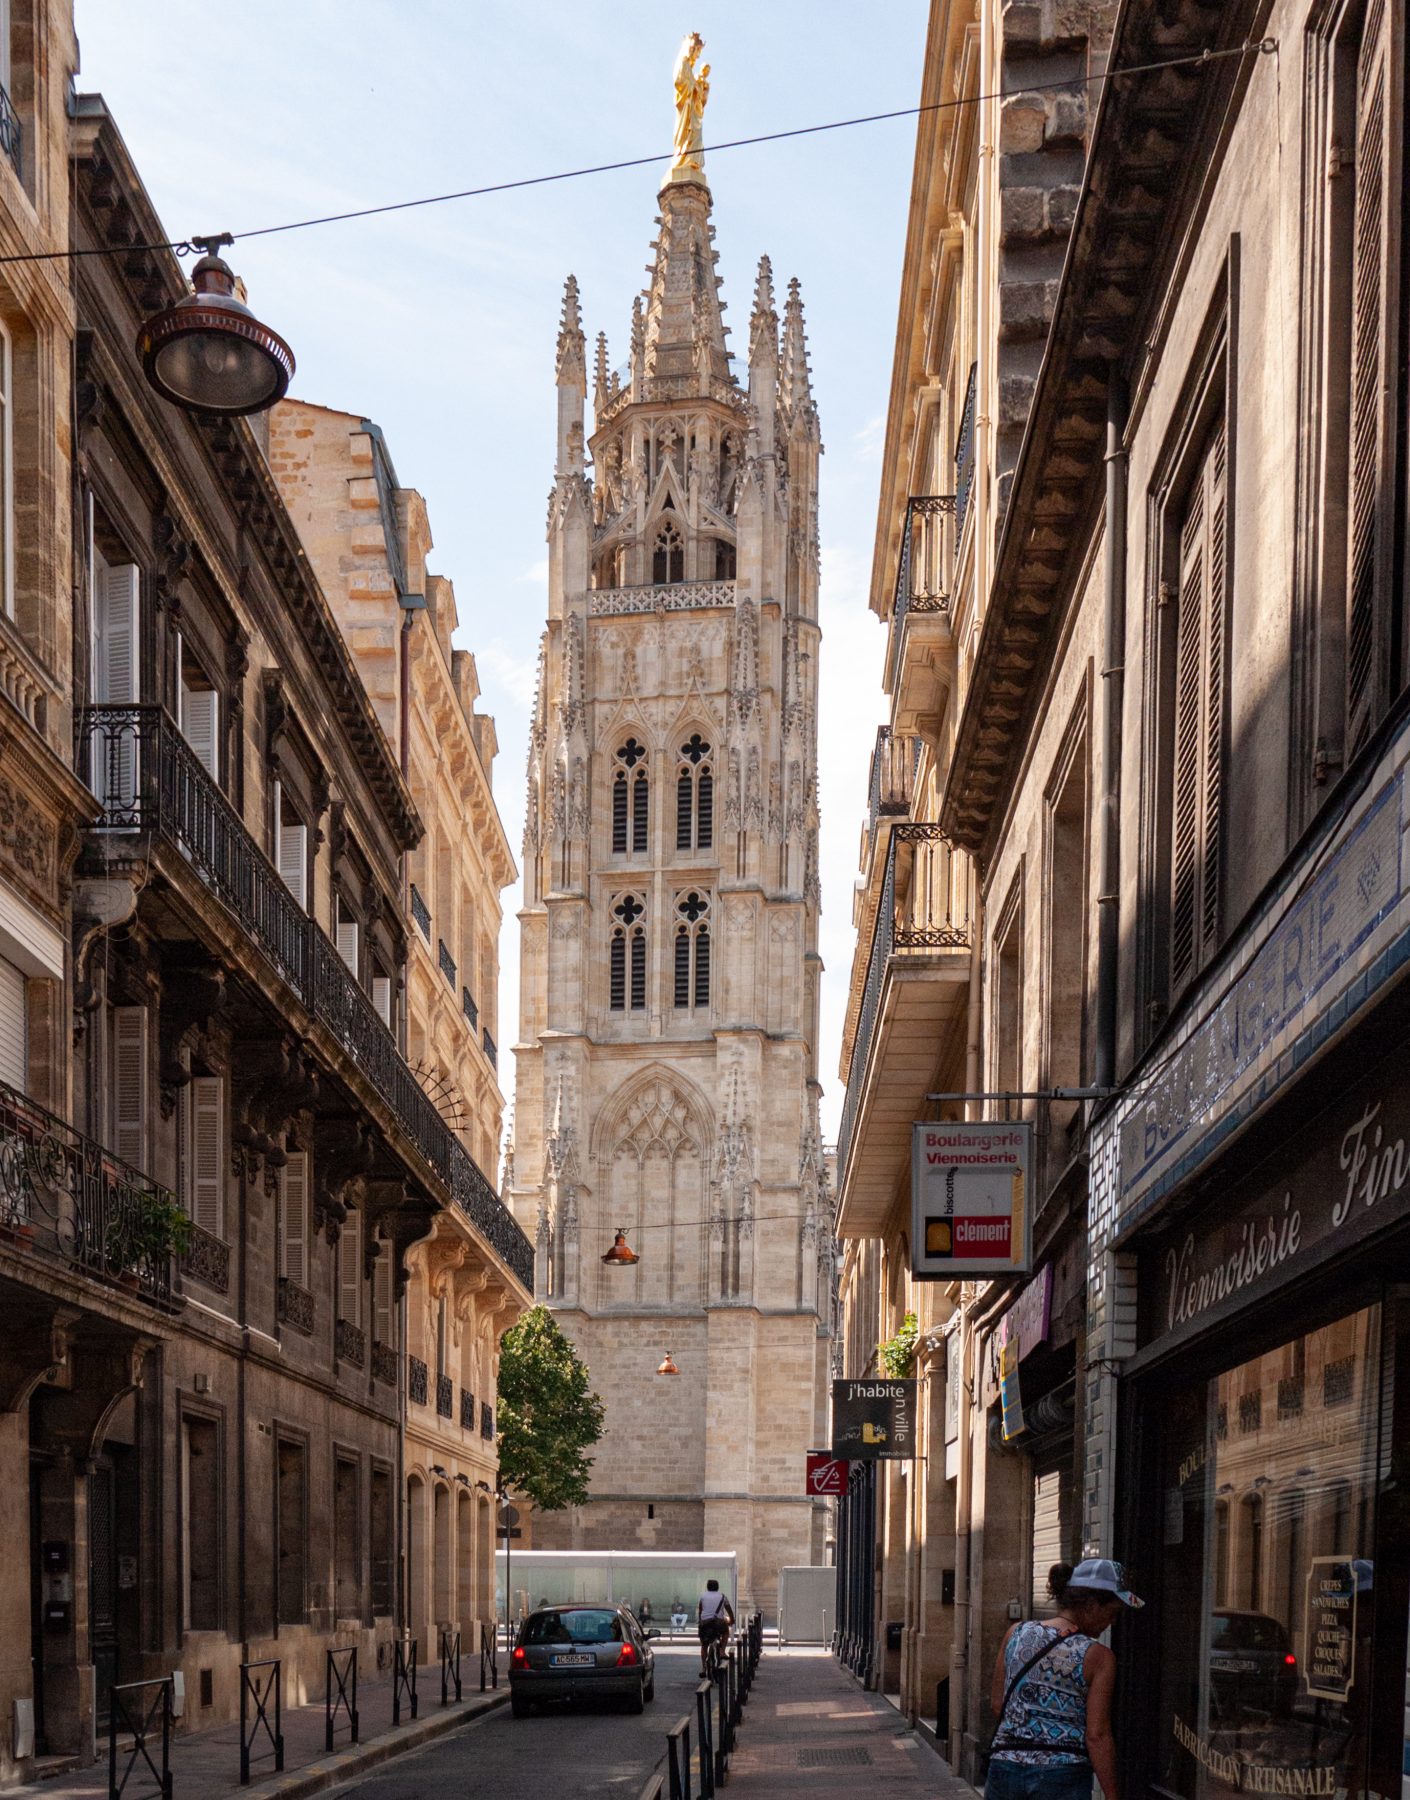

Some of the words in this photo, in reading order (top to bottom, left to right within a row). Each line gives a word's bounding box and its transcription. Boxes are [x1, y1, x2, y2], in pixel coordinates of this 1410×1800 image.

[926, 1132, 1024, 1150] Boulangerie
[926, 1151, 1017, 1165] Viennoiserie
[956, 1220, 1010, 1242] clément
[1166, 1192, 1301, 1329] Viennoiserie
[848, 1384, 905, 1401] j'habite
[895, 1412, 909, 1442] ville
[1321, 1614, 1338, 1626] PIZZA
[1317, 1630, 1340, 1644] QUICHE
[1173, 1714, 1242, 1785] FABRICATION
[1245, 1766, 1336, 1795] ARTISANALE
